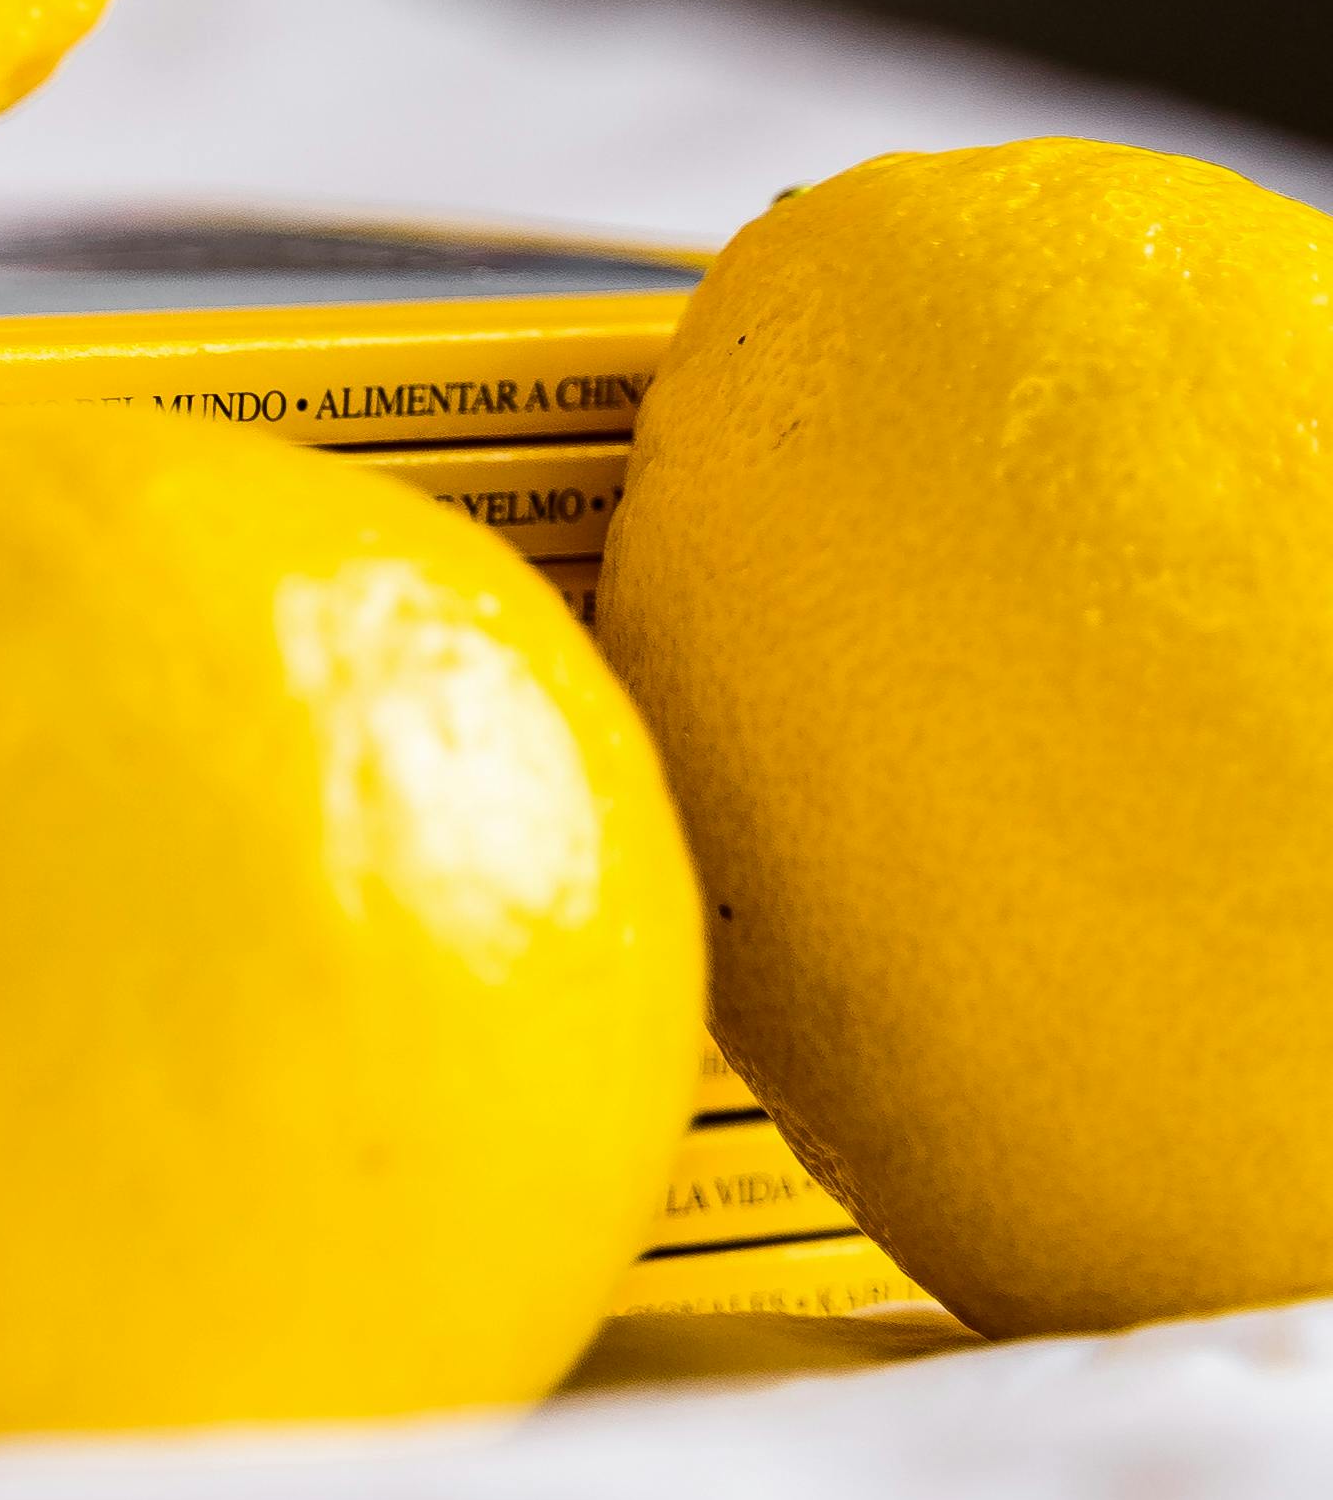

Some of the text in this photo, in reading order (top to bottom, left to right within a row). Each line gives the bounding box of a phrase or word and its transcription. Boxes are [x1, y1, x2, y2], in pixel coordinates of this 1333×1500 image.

[315, 381, 518, 420] ALIMENTAR
[524, 378, 551, 413] A
[666, 1172, 797, 1217] LA VIDA
